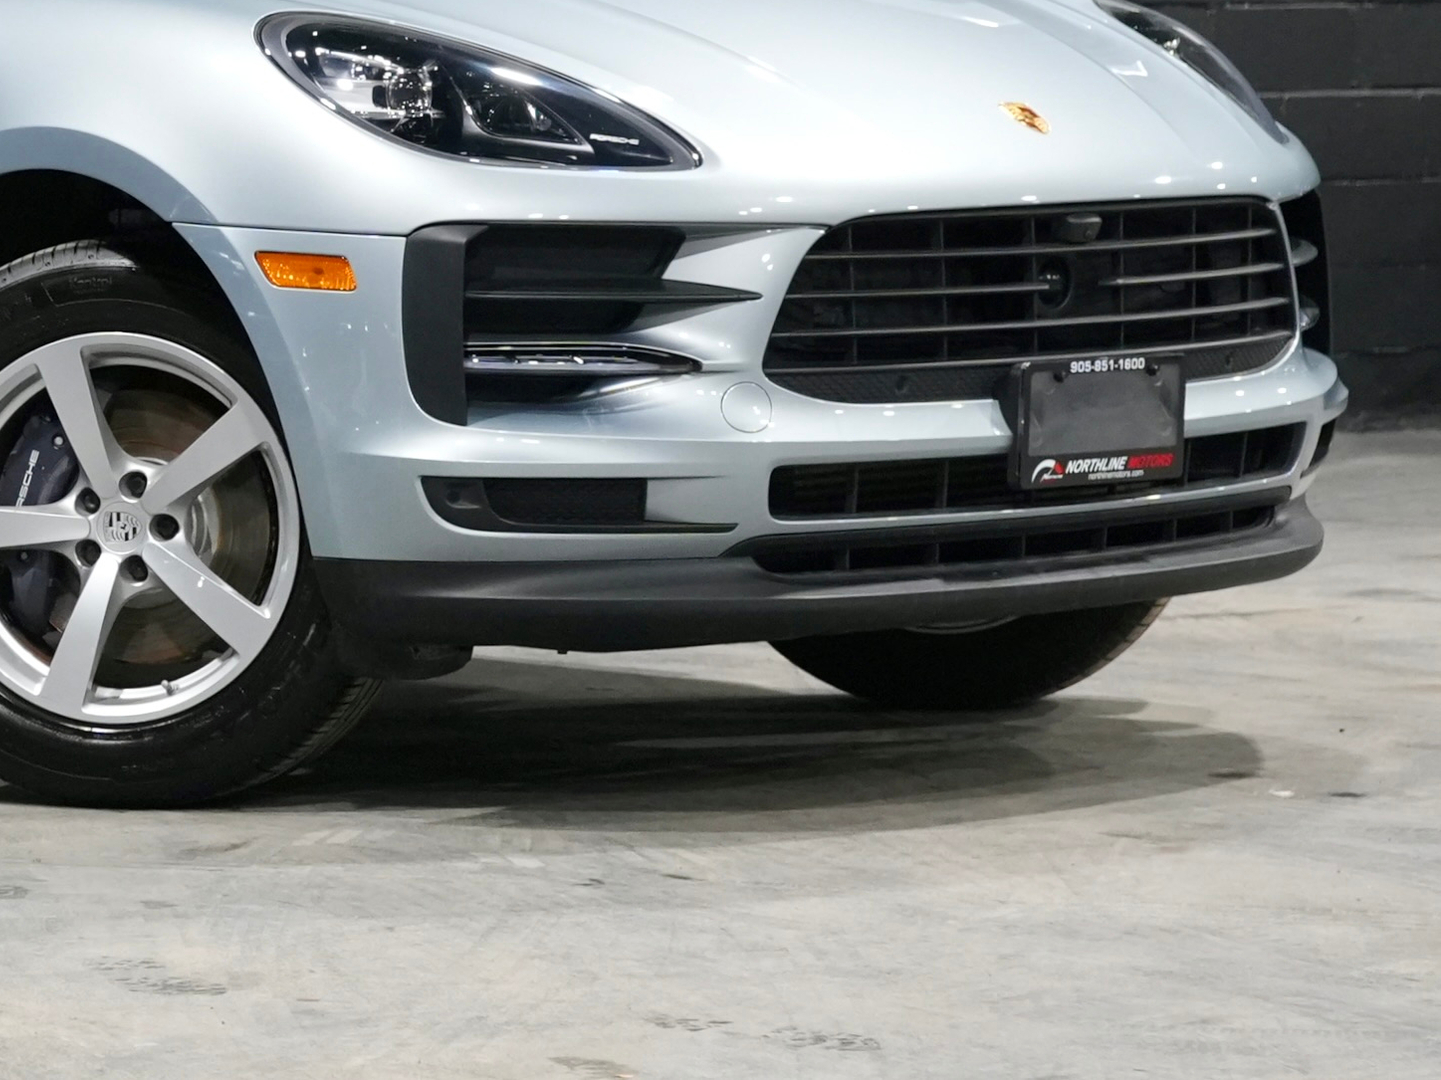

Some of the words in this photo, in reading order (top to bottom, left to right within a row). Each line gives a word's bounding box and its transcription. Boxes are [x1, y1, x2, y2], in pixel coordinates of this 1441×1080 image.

[1070, 358, 1145, 373] 905-851-1600
[1065, 455, 1128, 474] NORTHLINE
[1127, 453, 1175, 469] MOTORS
[15, 449, 40, 508] RSCHE
